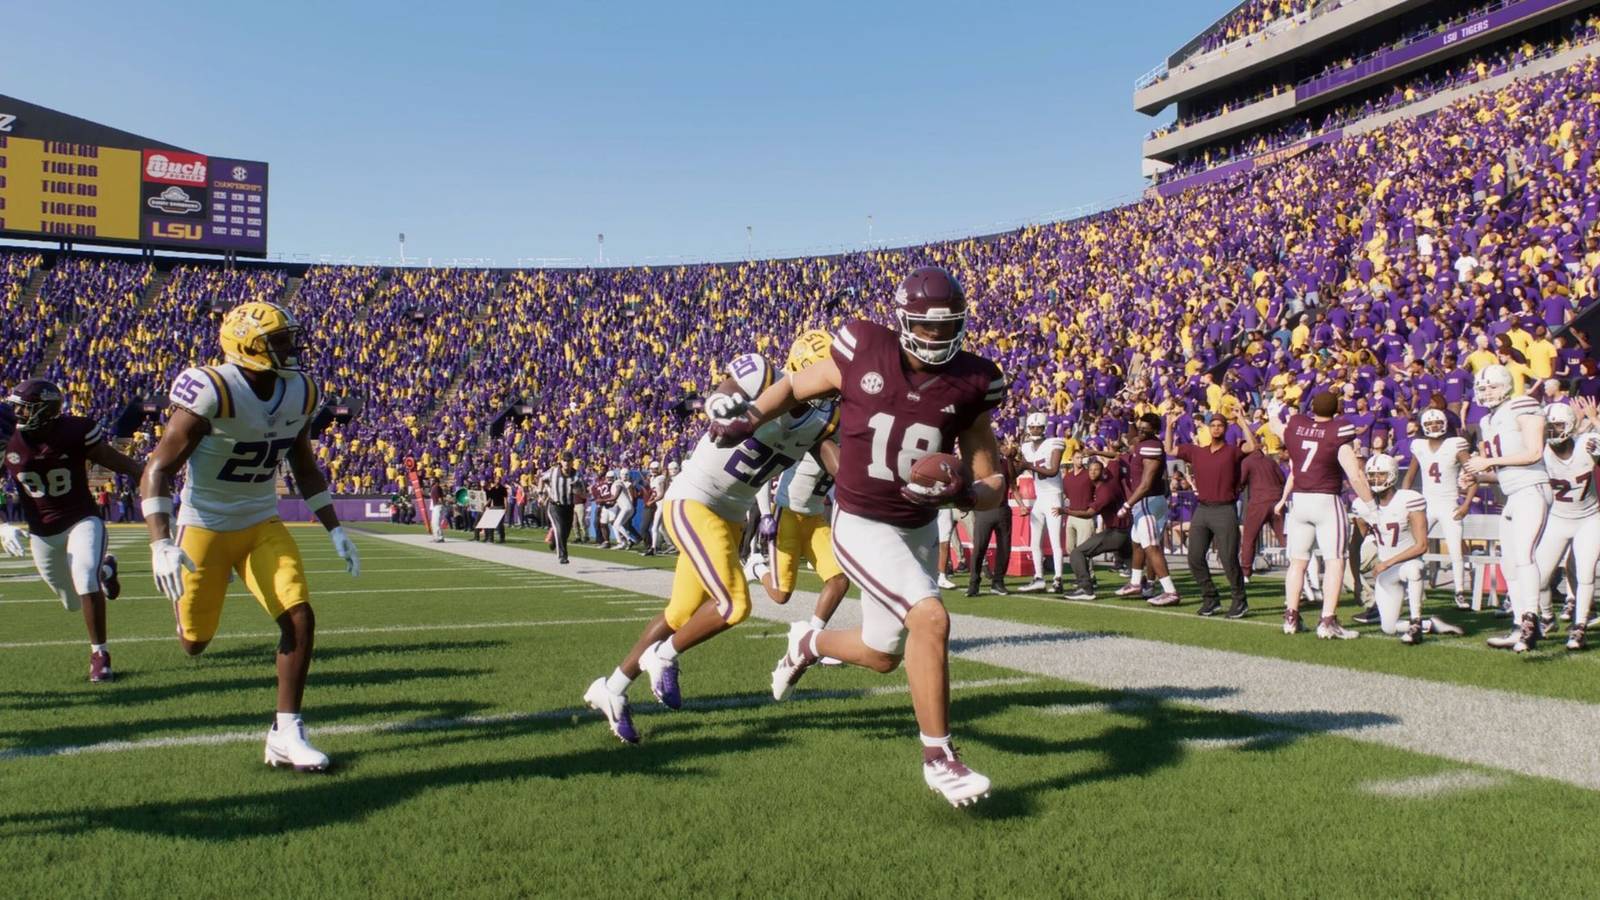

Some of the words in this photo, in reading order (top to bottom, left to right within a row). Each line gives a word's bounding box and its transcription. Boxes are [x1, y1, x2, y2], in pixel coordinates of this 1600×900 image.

[1443, 31, 1457, 45] LSU
[1461, 20, 1488, 38] TIGERS
[152, 221, 202, 240] LSU
[732, 355, 758, 379] 20
[172, 374, 205, 405] 25
[1296, 426, 1325, 439] BLANTON
[216, 437, 296, 483] 25
[868, 412, 942, 483] 18
[1301, 440, 1318, 472] 7
[1429, 462, 1442, 483] 4
[1550, 471, 1593, 502] 27
[1373, 523, 1400, 547] 17
